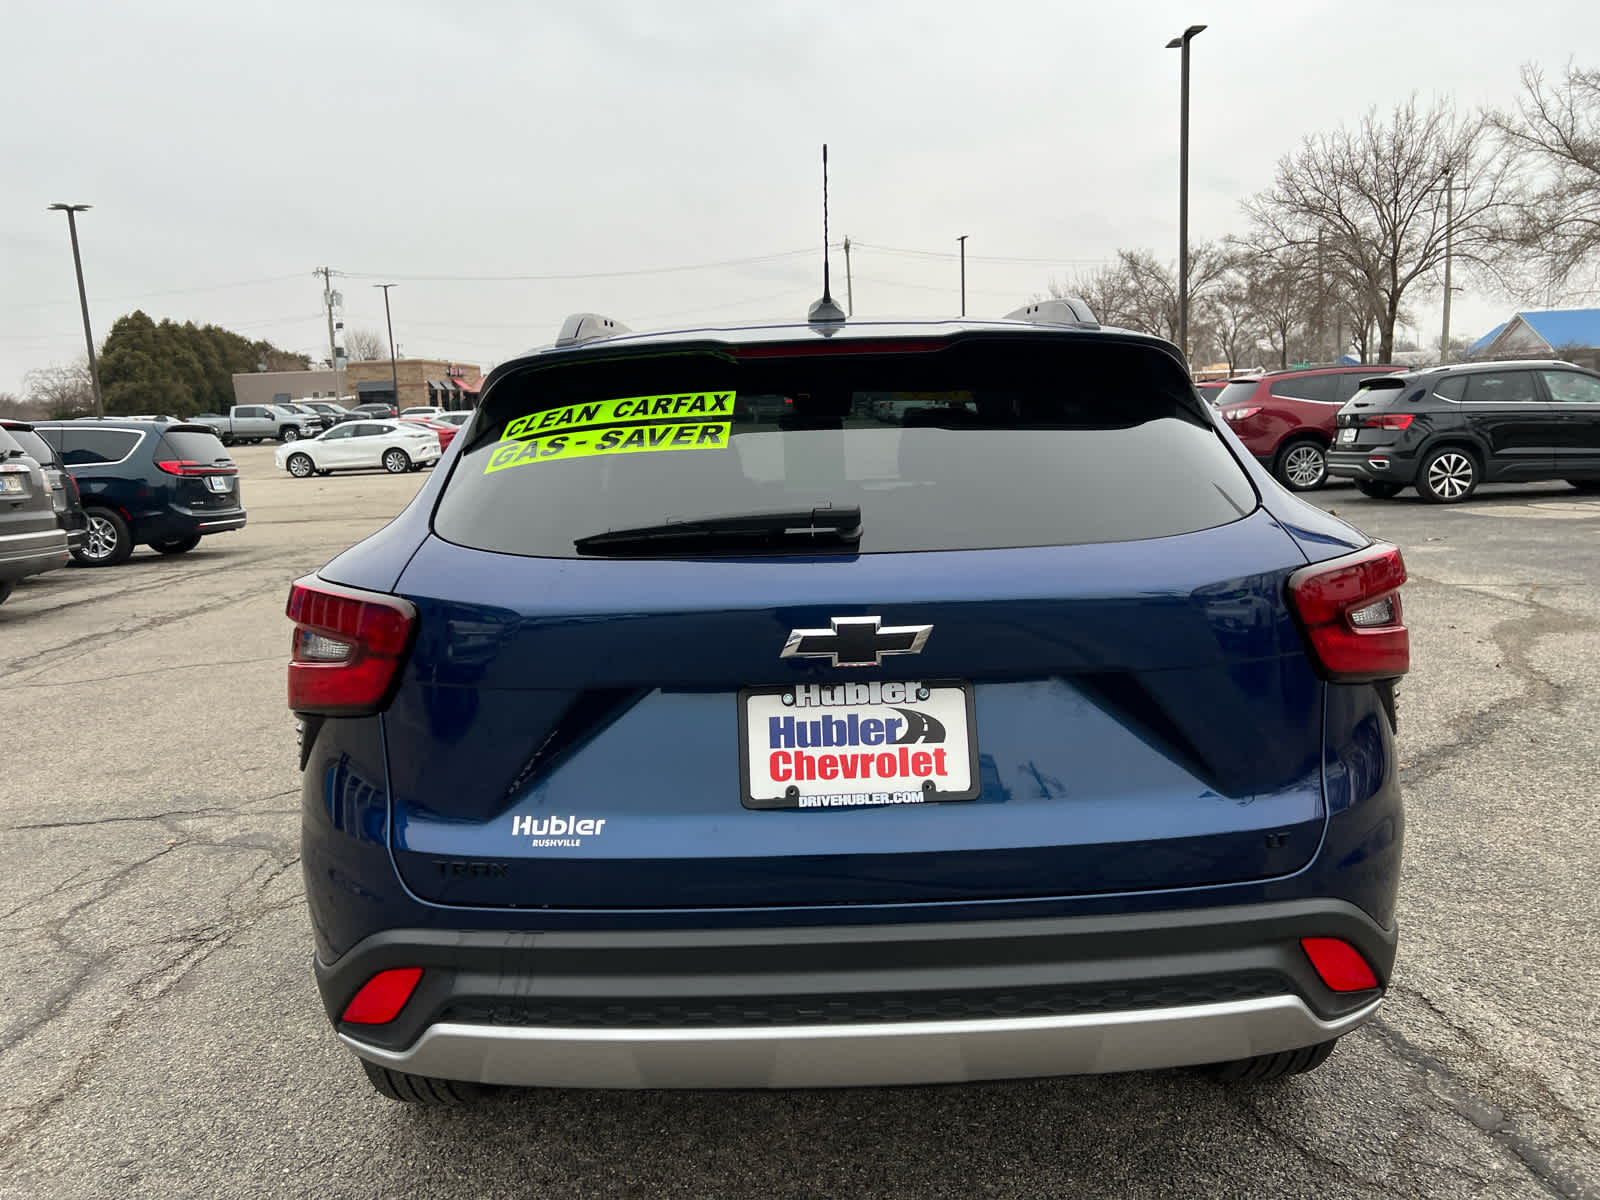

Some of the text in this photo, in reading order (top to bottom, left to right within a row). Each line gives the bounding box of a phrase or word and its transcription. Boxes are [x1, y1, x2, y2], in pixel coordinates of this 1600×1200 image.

[506, 393, 730, 437] CLEAN CARFAX
[795, 681, 922, 707] Hubler
[768, 713, 903, 749] Hubler
[769, 747, 949, 782] Chevrolet
[799, 791, 925, 808] DRIVEHUBLER.COM
[511, 815, 606, 836] Hubler
[532, 838, 581, 847] RUSHVILLE
